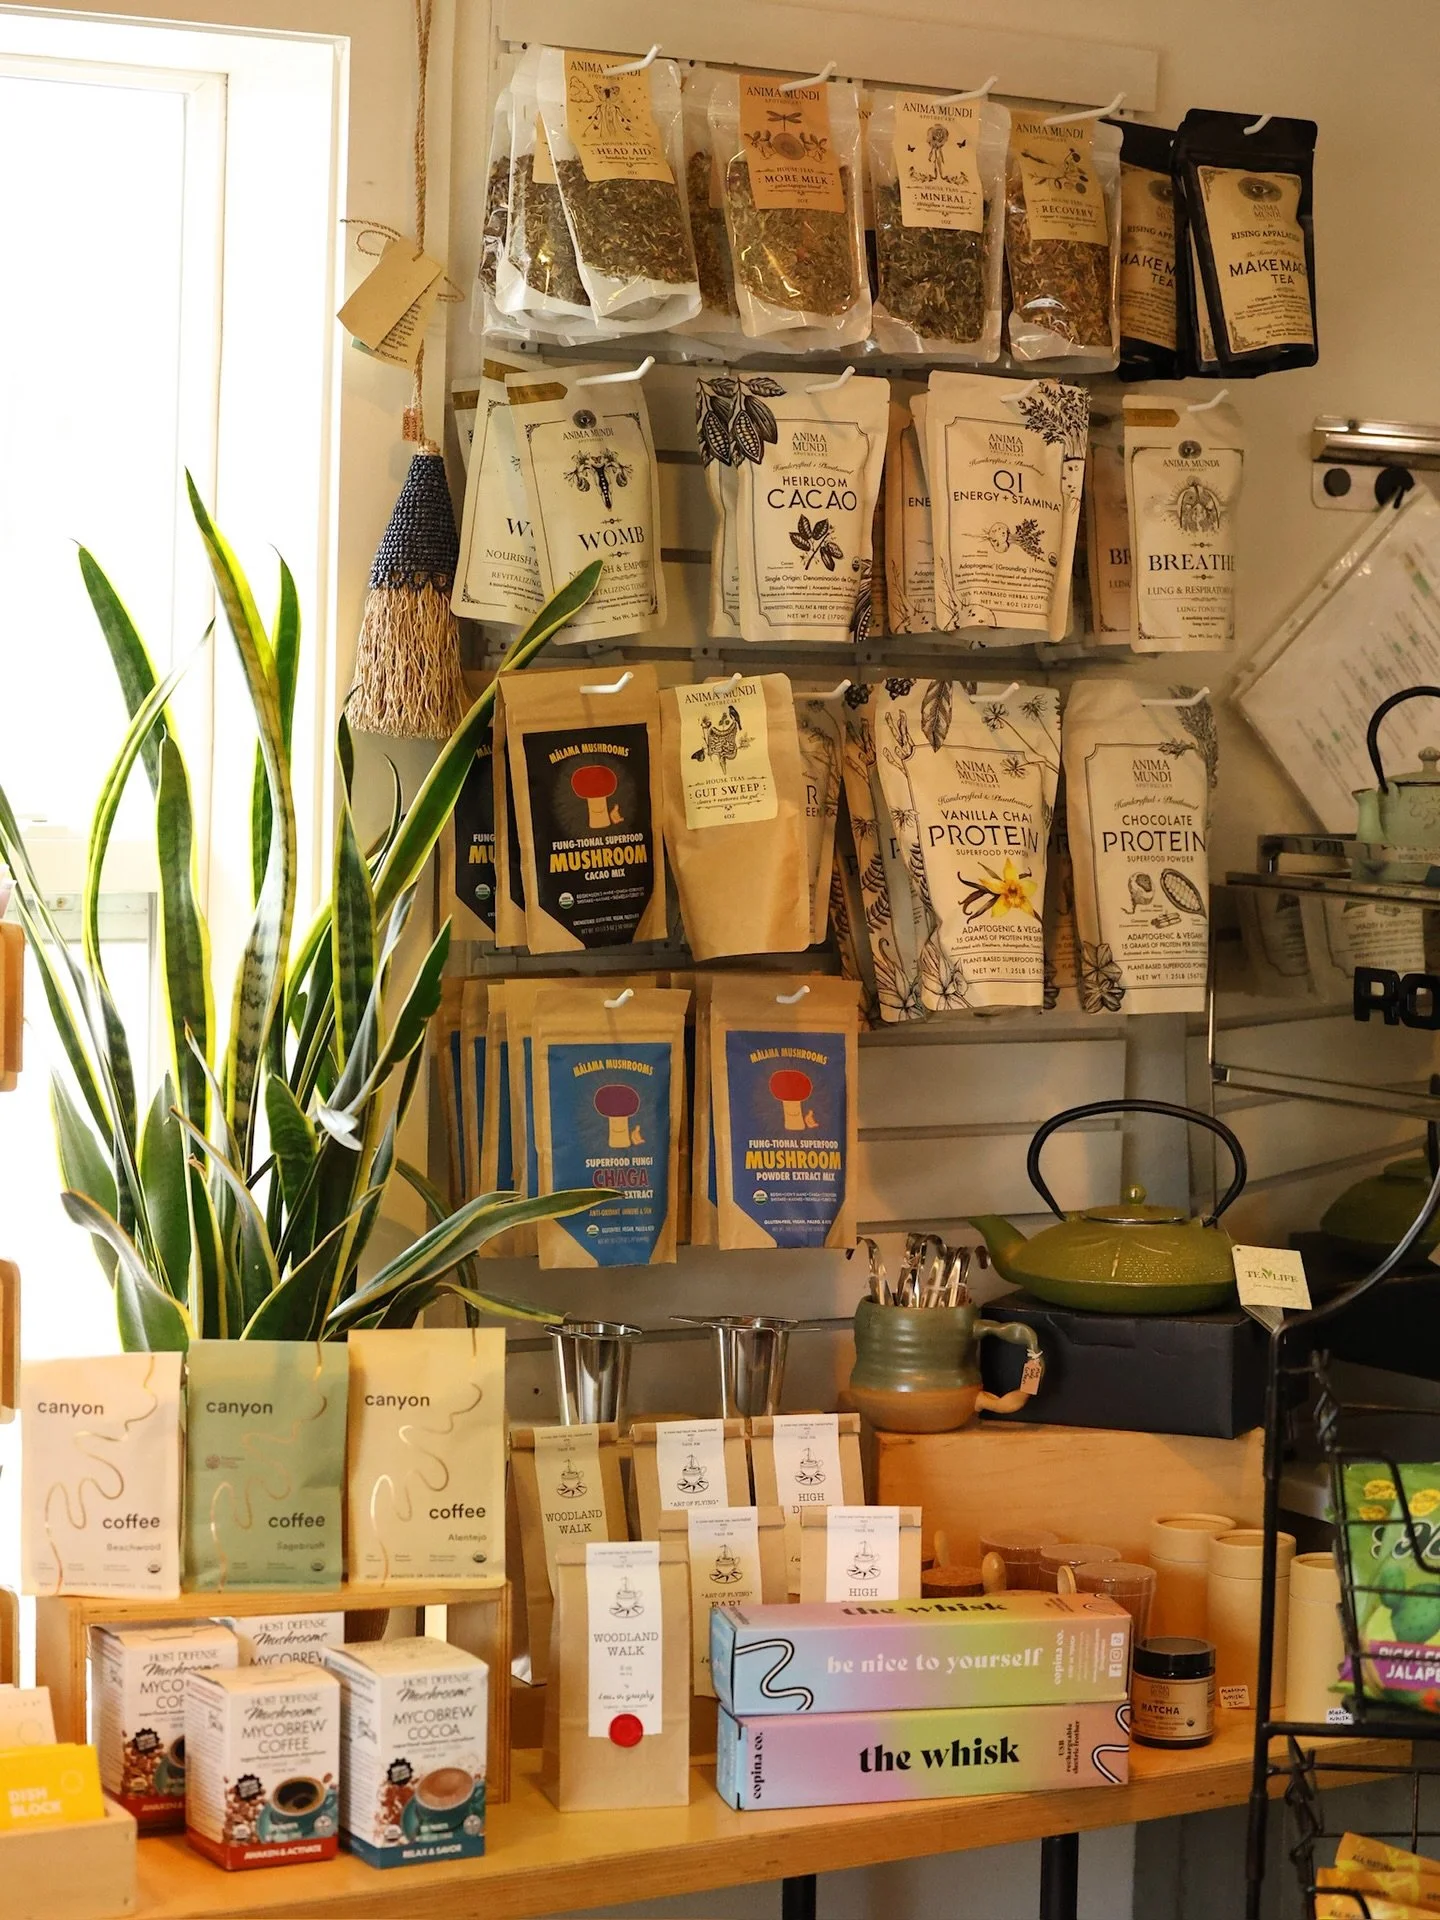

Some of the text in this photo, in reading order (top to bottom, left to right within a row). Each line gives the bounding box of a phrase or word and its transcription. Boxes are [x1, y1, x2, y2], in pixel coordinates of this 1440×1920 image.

[570, 60, 604, 74] ANIMA
[746, 86, 820, 101] ANIMA MUNDI
[902, 102, 973, 119] ANIMA MUNDI
[1016, 123, 1084, 139] ANIMA MUNDI
[597, 147, 652, 156] HEAD AID
[764, 174, 829, 186] MORE MILK
[920, 192, 965, 204] MINERAL
[1041, 204, 1094, 218] RECOVERY
[1231, 230, 1261, 240] RISING
[1151, 273, 1175, 288] TEA
[1271, 273, 1295, 285] TEA
[562, 427, 615, 441] ANIMA MUNDI
[792, 431, 827, 443] ANIMA
[988, 433, 1024, 445] ANIMA
[792, 441, 828, 453] MUNDI
[989, 441, 1024, 453] MUNDI
[1163, 458, 1220, 468] ANIMA MUNDI
[782, 475, 848, 488] HEIRLOOM
[993, 469, 1023, 497] QI
[767, 488, 858, 511] CACAO
[908, 498, 931, 508] ENE
[953, 491, 1000, 502] ENERGY
[577, 525, 645, 552] WOMB
[486, 548, 532, 566] NOURISH
[616, 563, 622, 573] &
[490, 570, 543, 588] REVITALIZING
[1147, 586, 1183, 596] LUNG &
[685, 684, 757, 704] ANIMA MUNDI
[955, 759, 995, 774] ANIMA
[1132, 759, 1171, 771] ANIMA
[958, 769, 999, 784] MUNDI
[1133, 770, 1173, 783] MUNDI
[694, 782, 760, 799] GUT SWEEP
[937, 791, 983, 806] Handcrafted
[940, 810, 1033, 824] VANILLA CHAI
[1122, 814, 1193, 826] CHOCOLATE
[552, 832, 644, 851] FUNG-TIONAL SUPERFOOD
[928, 825, 1039, 853] PROTEIN
[1102, 830, 1206, 853] PROTEIN
[549, 844, 648, 873] MUSHROOM
[956, 848, 1001, 857] SUPERFOOD
[1127, 855, 1166, 863] SUPERFOOD
[584, 868, 626, 881] CACAO MIX
[962, 925, 1015, 935] ADAPTOGENIC
[1016, 925, 1022, 933] &
[1127, 932, 1174, 941] ADAPTOGENIC
[964, 934, 989, 943] GRAMS
[781, 1047, 829, 1065] MUSHROOMS
[605, 1058, 655, 1076] MUSHROOMS
[748, 1139, 839, 1149] FUNG-TIONAL SUPERFOOD
[585, 1156, 654, 1168] SUPERFOOD FUNGI
[744, 1150, 842, 1170] MUSHROOM
[592, 1168, 650, 1189] CHAGA
[756, 1171, 836, 1182] POWDER EXTRACT MIX
[1272, 1273, 1298, 1283] LIFE
[37, 1400, 105, 1417] canyon
[205, 1400, 273, 1417] canyon
[364, 1394, 431, 1411] canyon
[798, 1492, 824, 1502] HIGH
[428, 1503, 487, 1520] coffee
[545, 1509, 603, 1523] WOODLAND
[102, 1513, 160, 1530] coffee
[268, 1513, 326, 1529] coffee
[559, 1523, 592, 1535] WALK
[447, 1533, 488, 1542] Alentejo
[849, 1588, 878, 1597] HIGH
[842, 1602, 1008, 1616] the whisk
[258, 1618, 329, 1633] HOST DEFENSE
[253, 1632, 330, 1646] Mushrooms
[594, 1631, 659, 1644] WOODLAND
[149, 1649, 218, 1664] HOST DEFENSE
[607, 1645, 645, 1657] WALK
[1052, 1629, 1065, 1685] copina co.
[827, 1647, 1043, 1674] be nice to yourself
[403, 1673, 471, 1687] HOST DEFENSE
[251, 1693, 321, 1707] HOST DEFENSE
[396, 1686, 473, 1702] Mushrooms
[244, 1705, 323, 1721] Mushrooms
[392, 1705, 477, 1726] MYCOBREW
[1141, 1703, 1180, 1715] MATCHA
[242, 1718, 328, 1740] MYCOBREW
[407, 1724, 462, 1740] COCOA
[258, 1737, 310, 1754] COFFEE
[860, 1736, 1020, 1773] the whisk
[751, 1732, 765, 1799] copina co.
[8, 1788, 48, 1803] DISH
[10, 1801, 61, 1819] BLOCK
[428, 1848, 435, 1856] &
